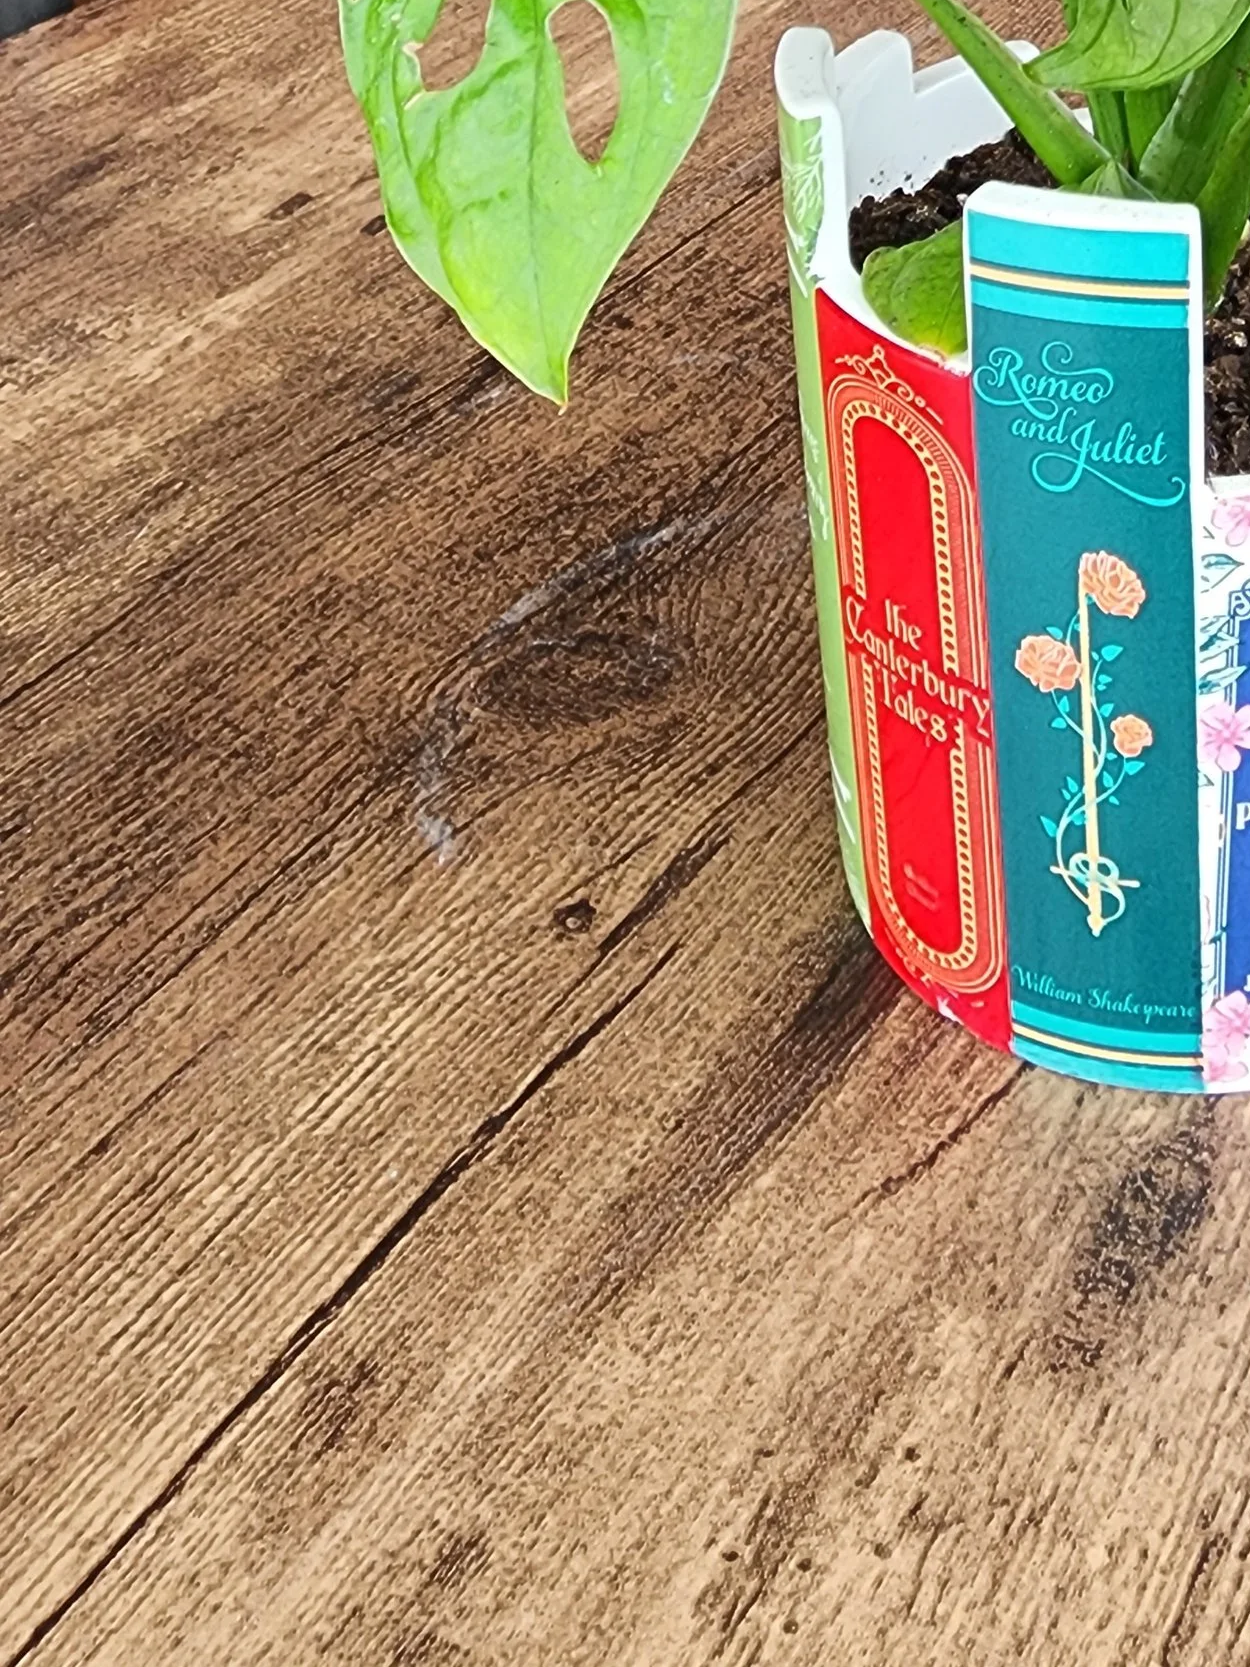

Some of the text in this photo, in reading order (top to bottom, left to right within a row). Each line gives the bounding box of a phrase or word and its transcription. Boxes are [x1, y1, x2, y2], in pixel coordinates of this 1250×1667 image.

[973, 341, 1114, 421] Romeo
[1011, 407, 1186, 508] and Juliet
[885, 598, 923, 651] The
[845, 596, 991, 738] Canterbury
[873, 659, 948, 743] Tales
[1011, 964, 1197, 1025] William Shakespeare
